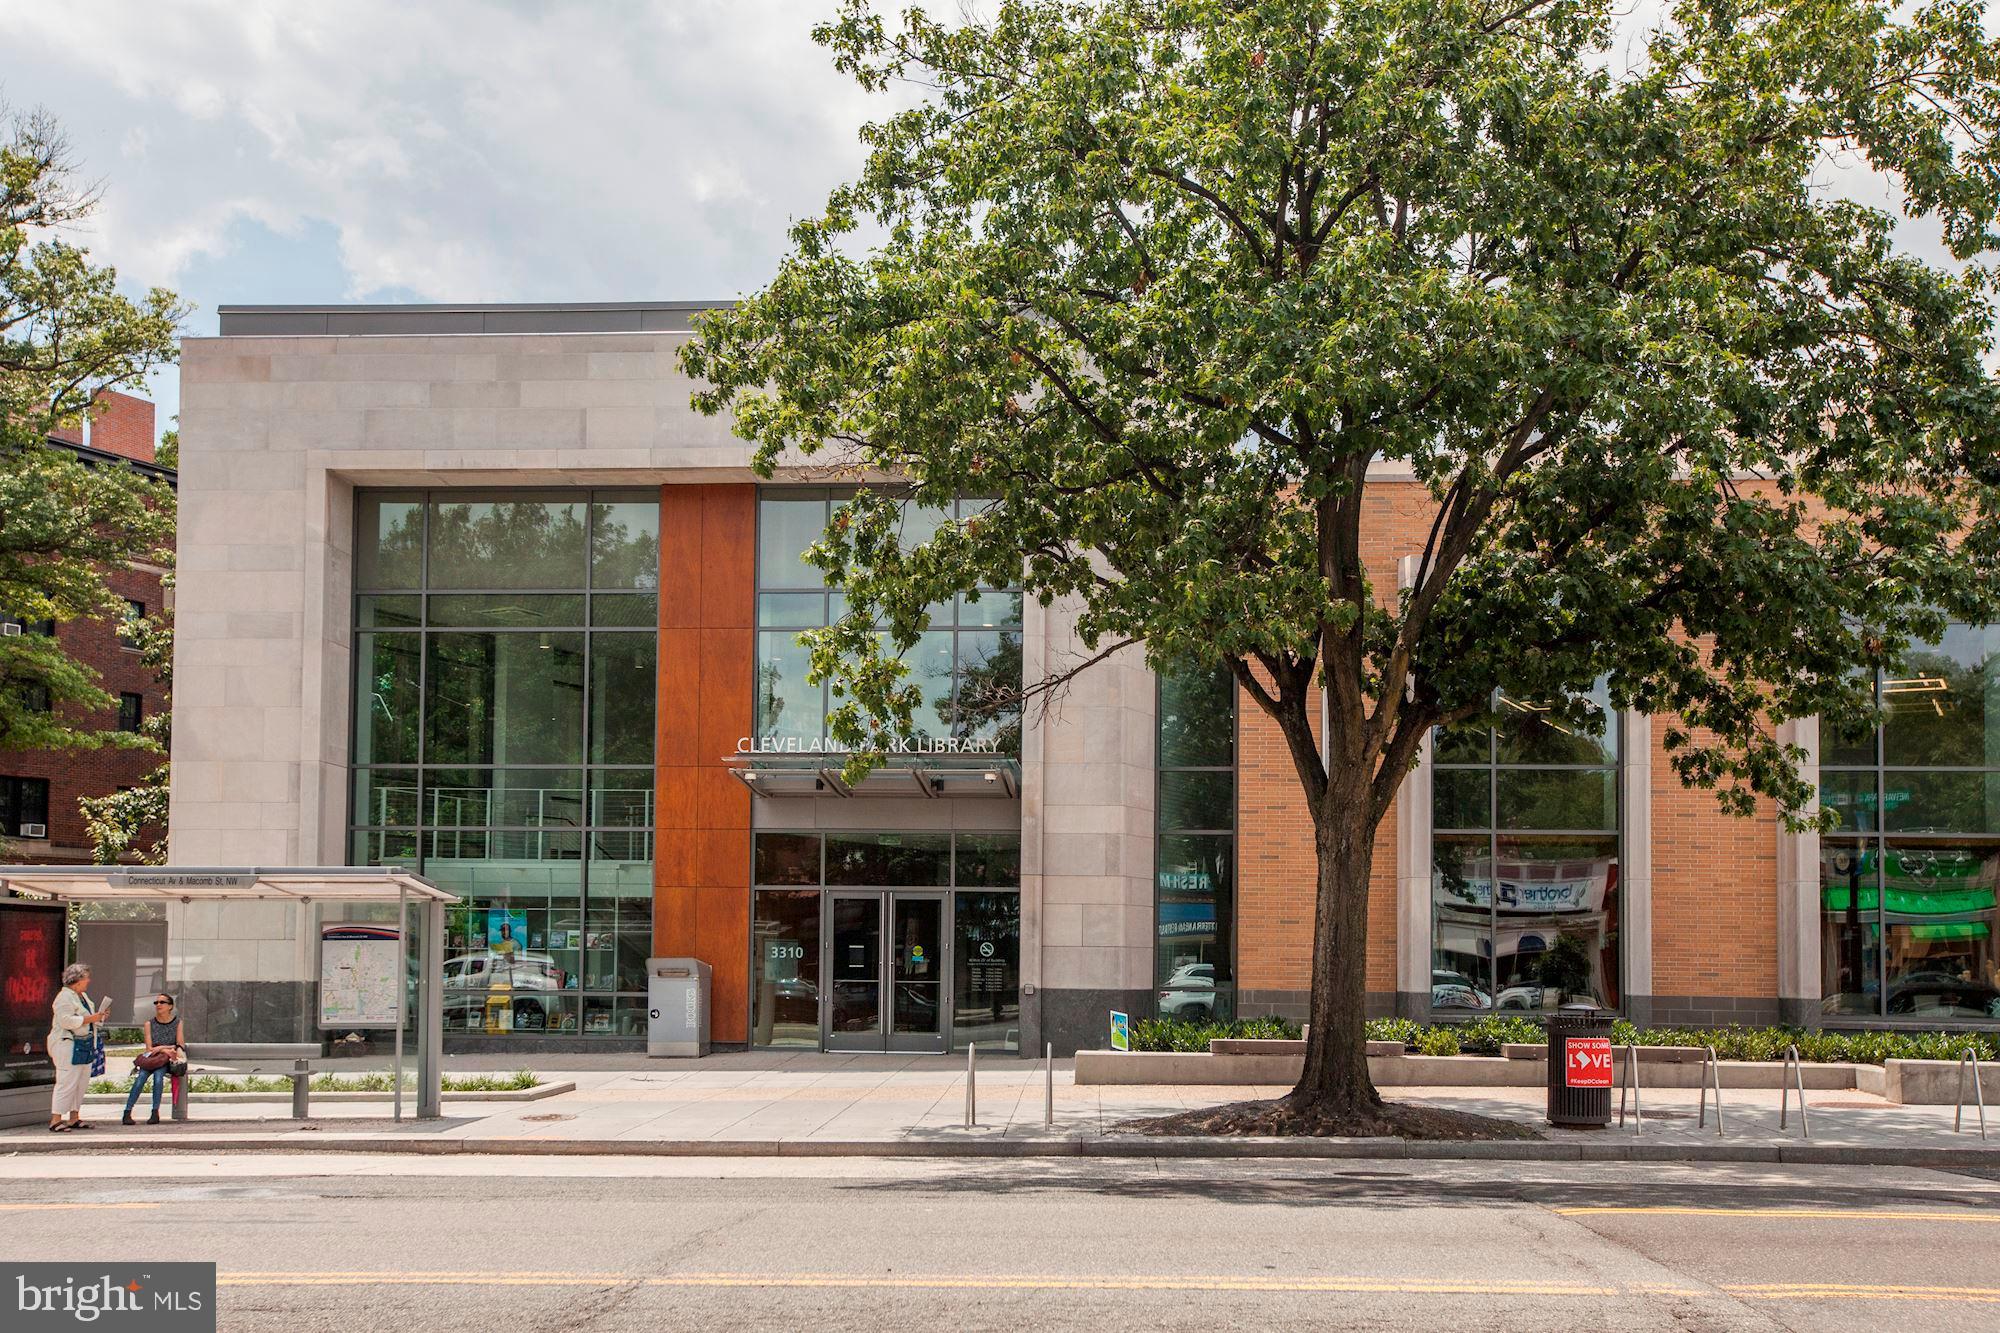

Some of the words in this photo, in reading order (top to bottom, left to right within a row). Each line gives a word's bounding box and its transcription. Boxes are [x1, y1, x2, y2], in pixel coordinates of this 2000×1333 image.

[917, 737, 1002, 753] LIBRARY
[128, 876, 166, 885] Connecticut
[178, 876, 184, 885] &
[186, 876, 213, 886] Macomb
[226, 876, 238, 886] NW
[771, 947, 804, 959] 3310
